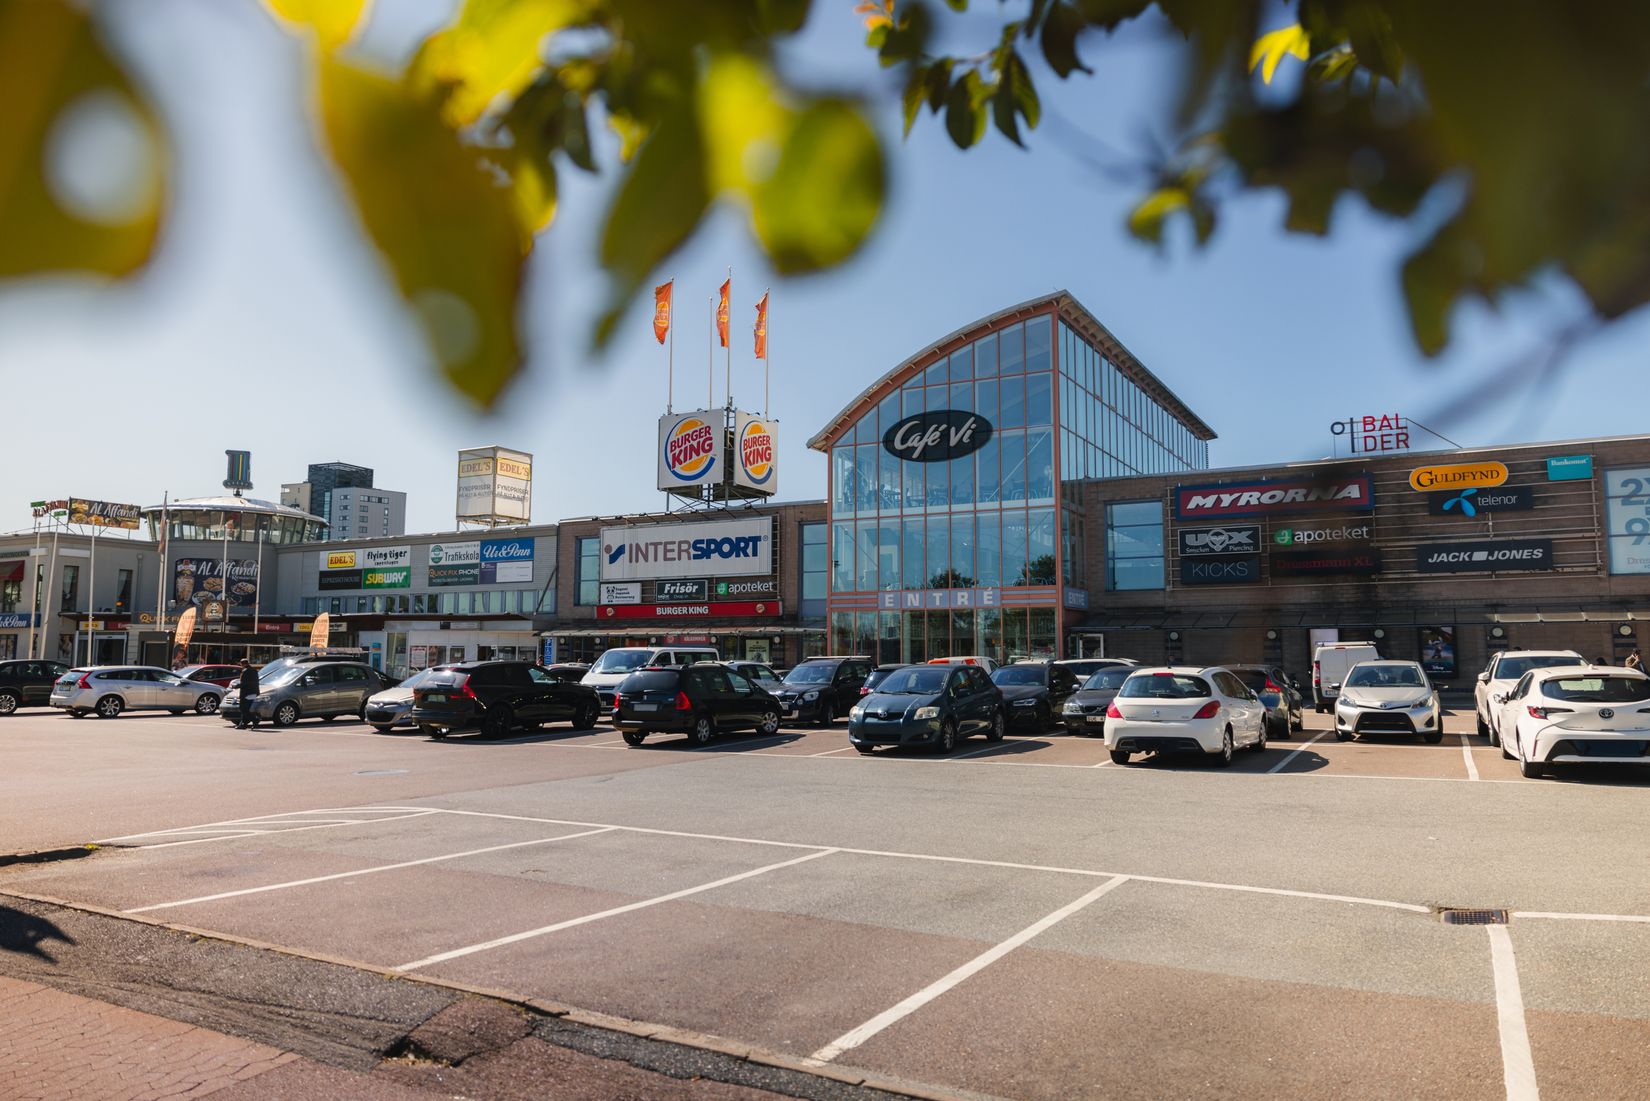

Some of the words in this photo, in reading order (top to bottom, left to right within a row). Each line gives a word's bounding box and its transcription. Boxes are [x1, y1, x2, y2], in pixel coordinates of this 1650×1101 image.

[1362, 413, 1408, 433] BAL
[670, 425, 712, 454] BURGER
[743, 435, 771, 452] BURGER
[894, 420, 948, 459] Café
[949, 416, 977, 447] Vi
[1363, 432, 1410, 453] DER
[671, 436, 714, 470] KING
[744, 446, 772, 469] KING
[461, 461, 491, 474] EDEL'S
[499, 462, 529, 477] EDEL'S
[1551, 458, 1587, 466] Bankomat
[1416, 469, 1500, 488] GULDFYND
[1186, 484, 1361, 510] MYRORNA
[1477, 493, 1520, 508] telenor
[90, 502, 103, 515] AL
[1294, 525, 1370, 545] apoteket
[1625, 517, 1650, 545] 9
[367, 551, 388, 560] flying
[388, 549, 408, 560] tiger
[444, 550, 480, 562] Trafikskola
[628, 535, 762, 564] INTERSPORT
[1428, 551, 1473, 564] JACK
[1487, 548, 1544, 561] JONES
[329, 555, 354, 565] EDEL'S
[197, 561, 213, 576] AL
[429, 568, 447, 577] QUICK
[1192, 561, 1249, 577] KICKS
[365, 571, 407, 584] SUBWAY
[664, 582, 699, 594] Frisör
[728, 580, 774, 595] apoteket
[884, 586, 994, 607] ENTRÉ
[656, 606, 688, 615] BURGER
[688, 605, 709, 614] KING
